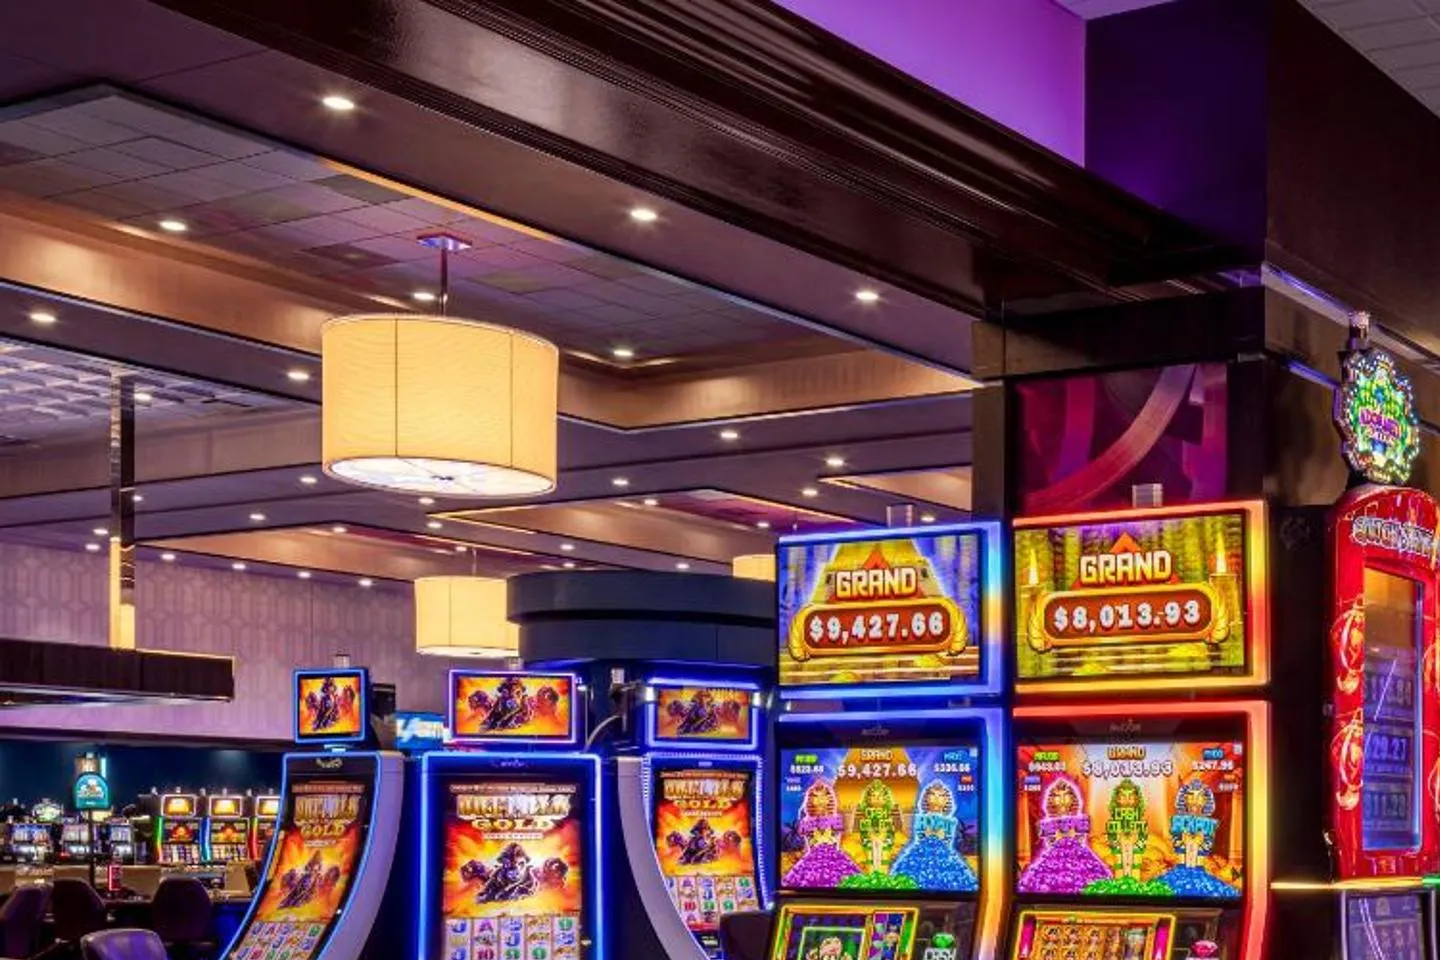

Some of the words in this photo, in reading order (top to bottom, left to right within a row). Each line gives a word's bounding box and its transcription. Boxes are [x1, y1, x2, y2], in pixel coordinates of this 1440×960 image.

[834, 565, 917, 599] GRAND
[1079, 550, 1173, 585] GRAND
[809, 610, 945, 643] $9,427.66
[1053, 599, 1201, 632] $8,013.93
[837, 763, 917, 779] $9,427.66
[471, 818, 556, 831] GOLD
